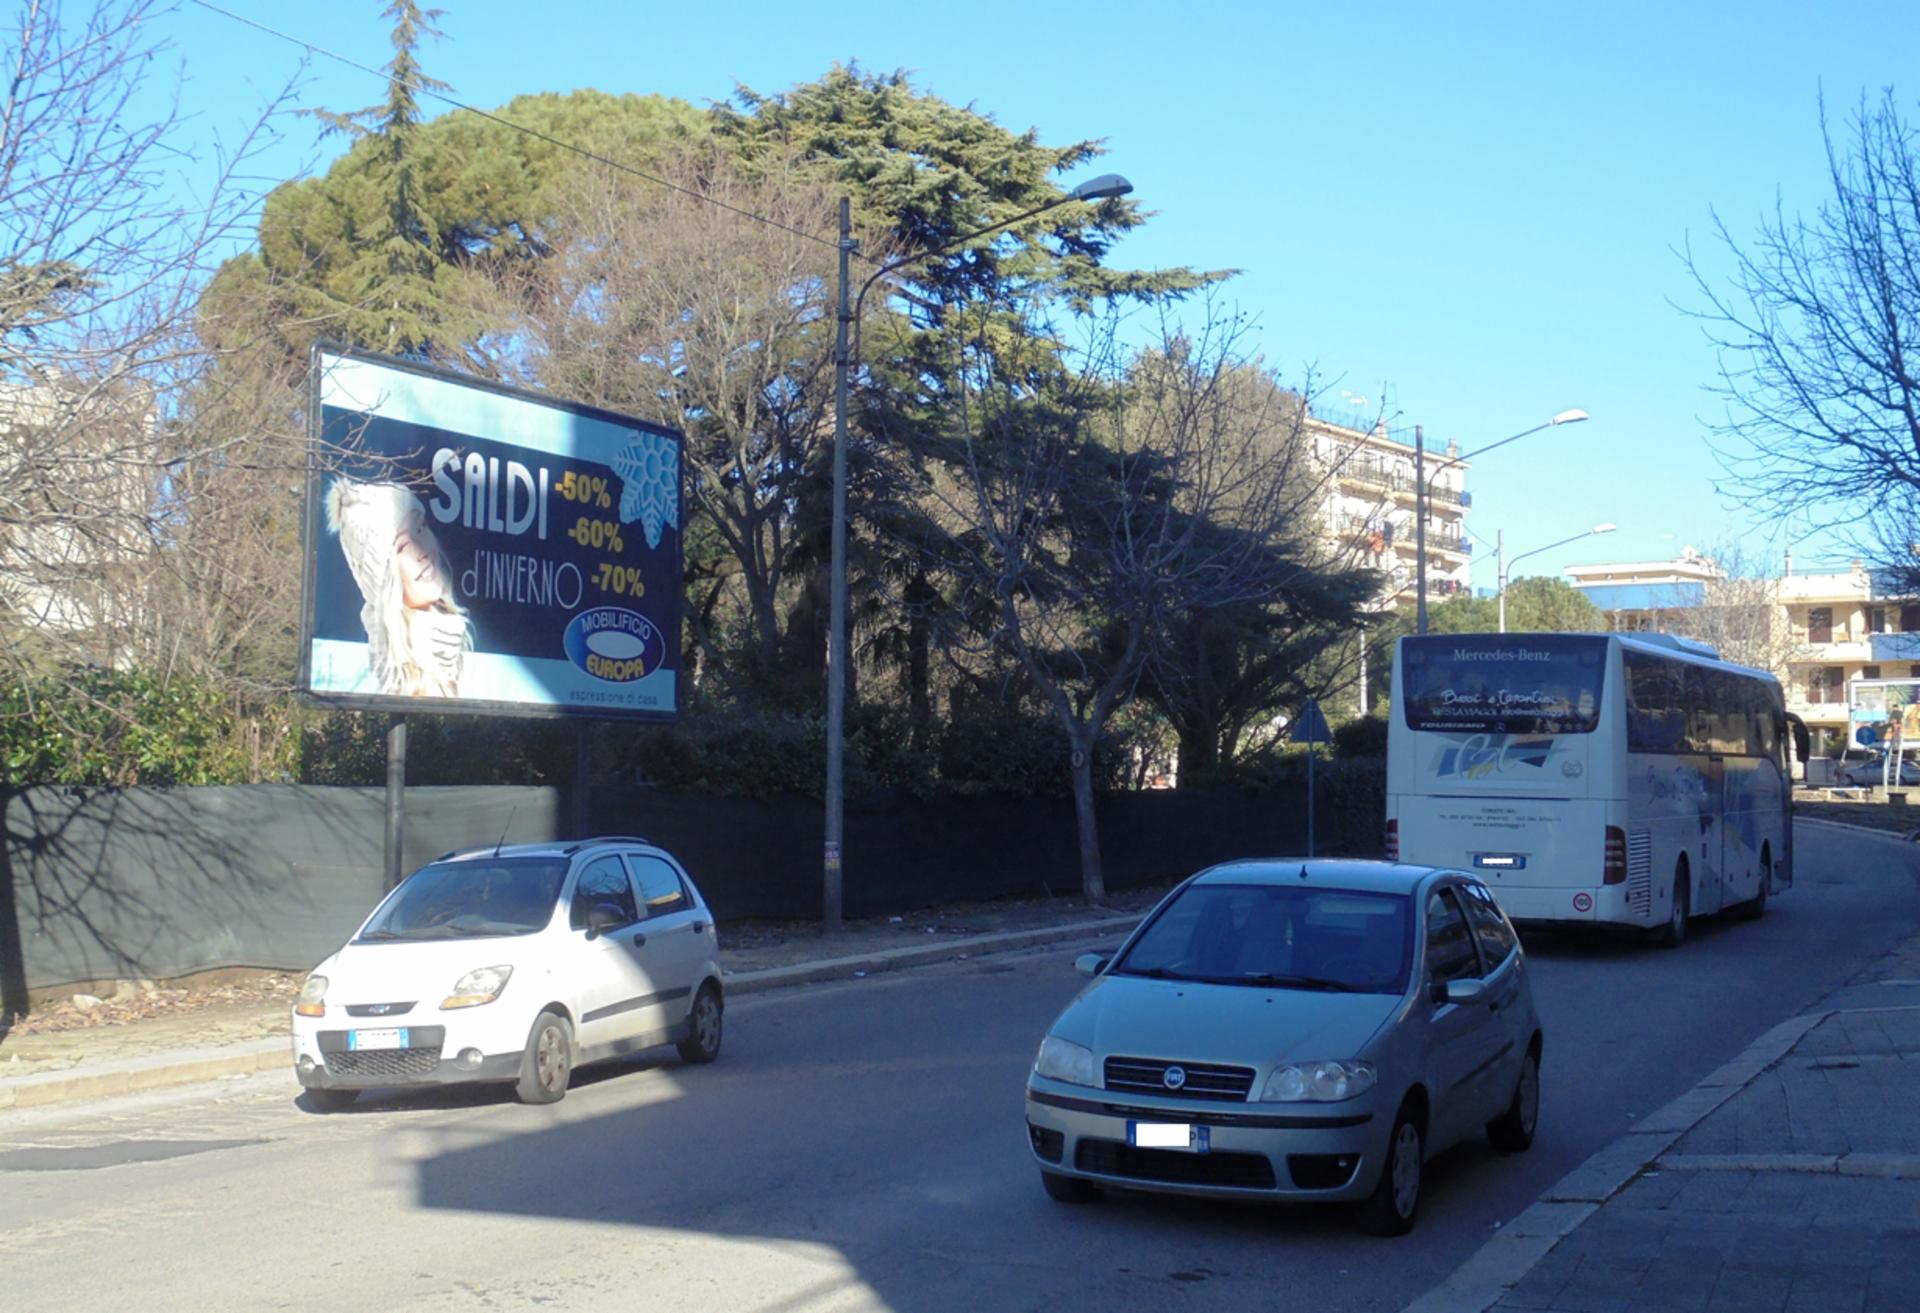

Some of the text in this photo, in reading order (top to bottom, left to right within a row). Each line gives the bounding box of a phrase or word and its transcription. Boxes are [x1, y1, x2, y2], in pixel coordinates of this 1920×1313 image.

[430, 448, 549, 540] SALDI
[555, 470, 612, 509] -50%
[568, 516, 624, 553] -60%
[461, 549, 583, 610] d'INVERNO
[591, 562, 646, 598] -70%
[580, 611, 651, 640] MOBILIFICIO
[586, 653, 645, 681] EUROPA
[1453, 649, 1551, 662] Mercedes-Benz
